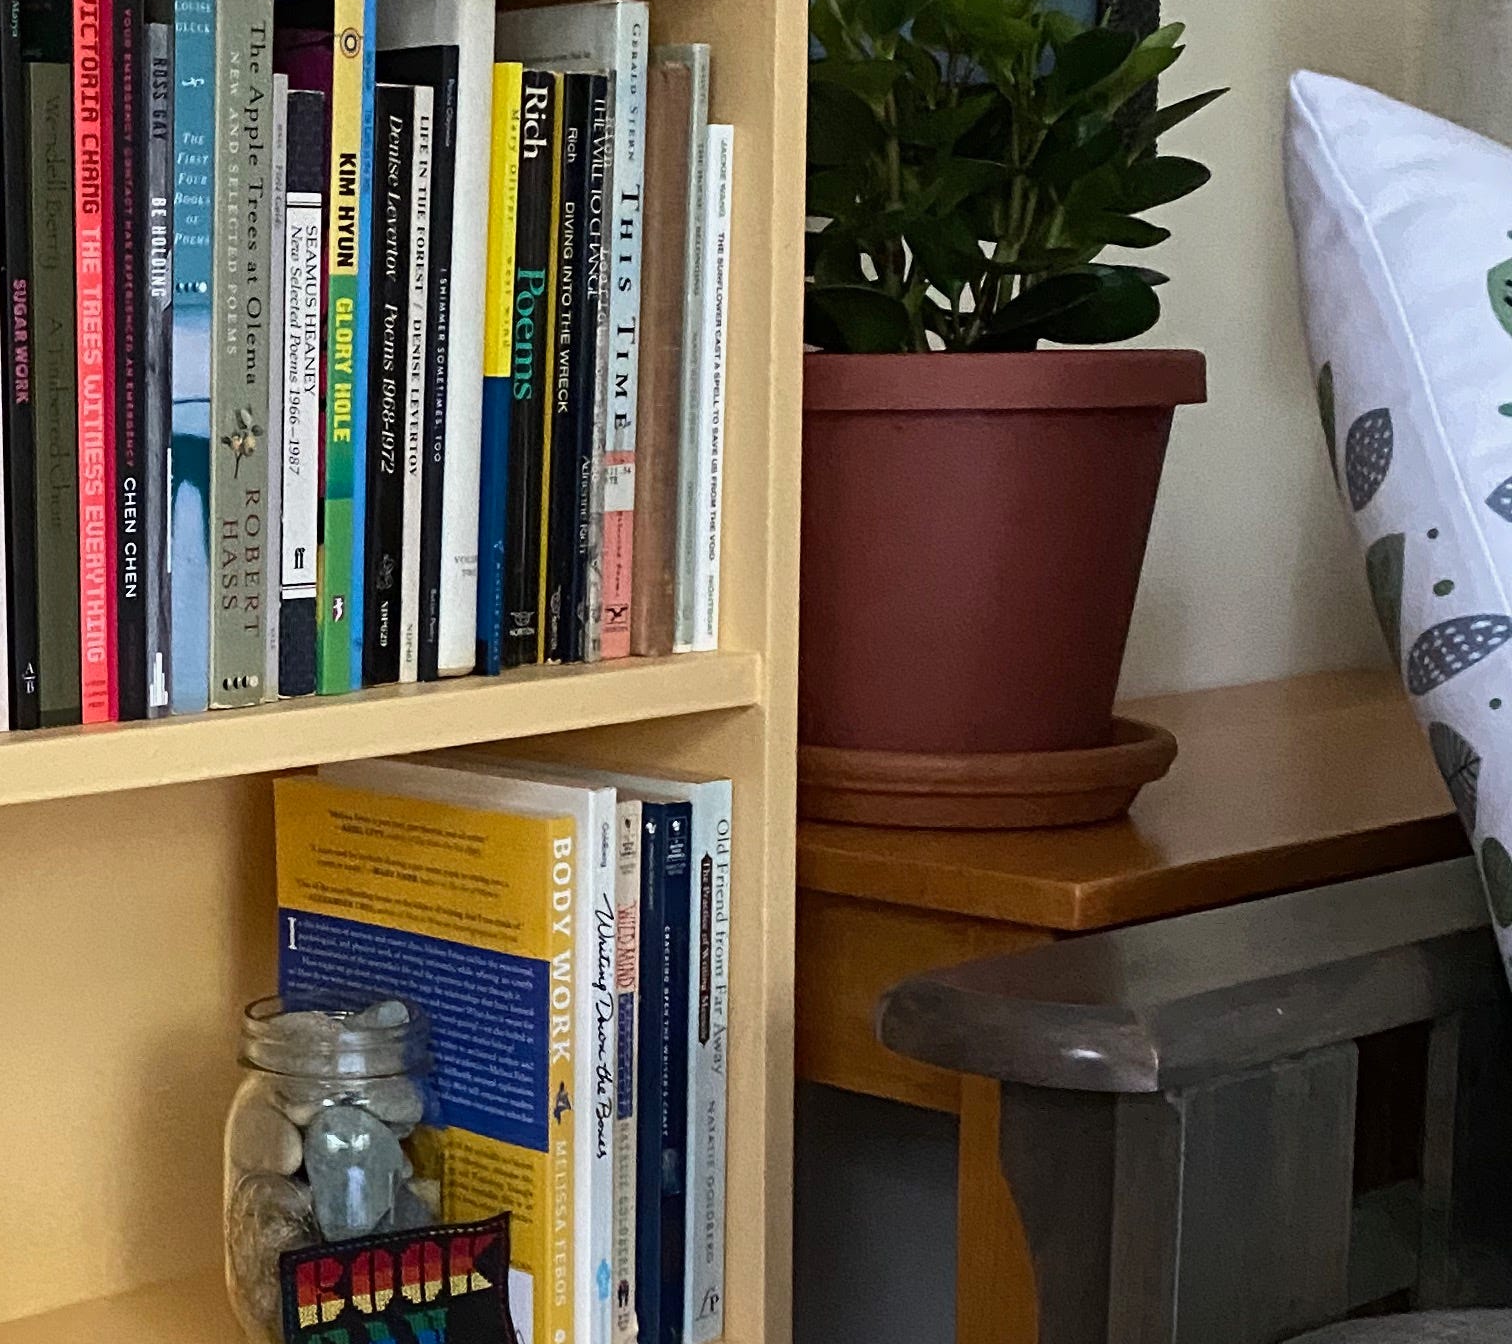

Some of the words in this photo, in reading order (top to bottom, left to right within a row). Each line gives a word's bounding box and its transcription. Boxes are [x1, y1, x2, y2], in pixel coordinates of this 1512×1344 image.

[249, 21, 266, 75] The
[245, 86, 264, 166] Apple
[522, 86, 549, 159] Rich
[81, 133, 100, 214] CHANG
[248, 178, 264, 246] Trees
[339, 153, 356, 196] KIM
[82, 229, 100, 273] THE
[247, 262, 259, 283] at
[337, 206, 355, 267] HYUN
[82, 288, 102, 365] TREES
[245, 296, 264, 385] Olema
[334, 297, 353, 378] GLORY
[512, 267, 546, 400] Poems
[83, 374, 102, 496] WITNESS
[333, 384, 351, 443] HOLE
[123, 477, 136, 533] CHEN
[85, 504, 106, 662] EVERYTHING
[124, 542, 137, 598] CHEN
[222, 521, 238, 611] HASS
[244, 489, 260, 637] ROBERT
[552, 838, 572, 936] BODY
[552, 952, 570, 1065] WORK
